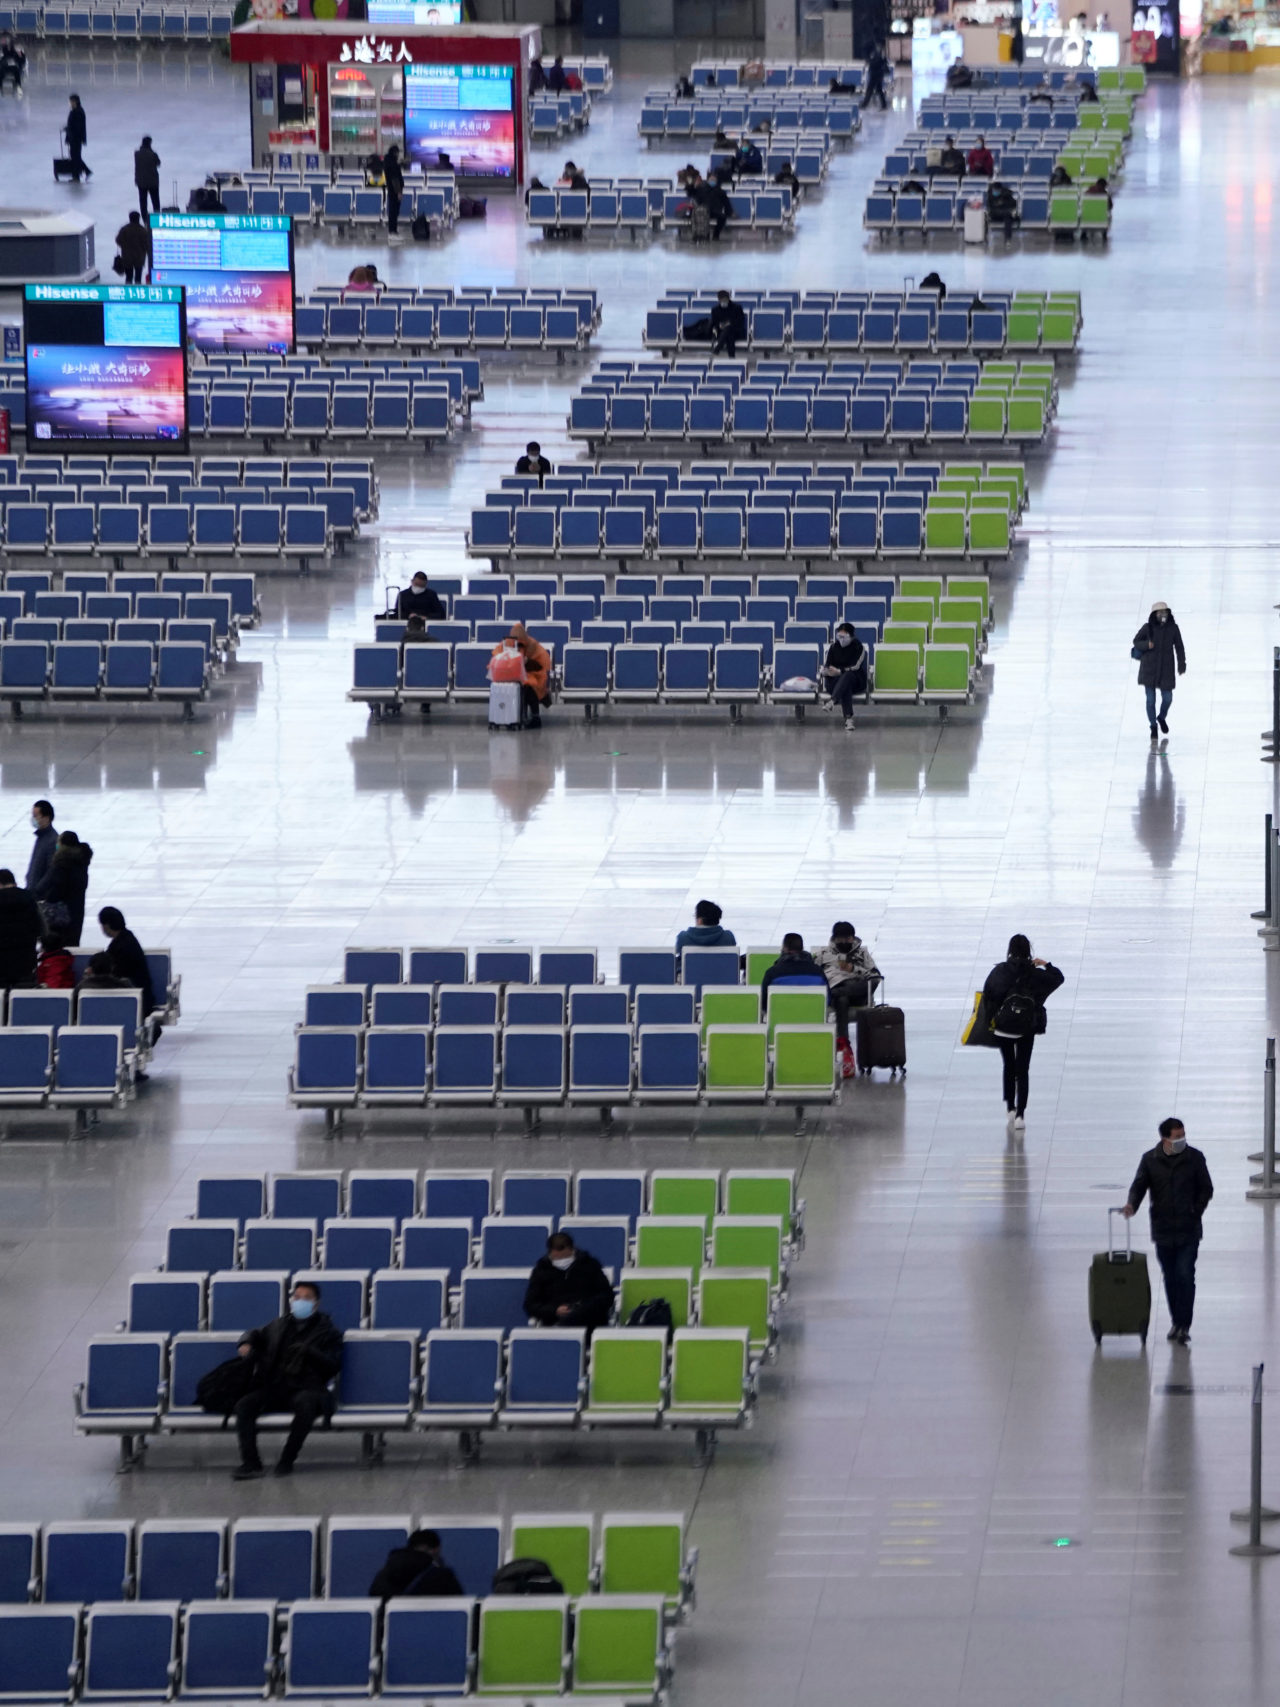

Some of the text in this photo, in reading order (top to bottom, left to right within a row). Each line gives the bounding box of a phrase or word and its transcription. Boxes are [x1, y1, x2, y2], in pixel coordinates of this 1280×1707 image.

[411, 65, 456, 77] Hisense
[159, 214, 216, 228] Hisense
[35, 285, 100, 300] Hisense
